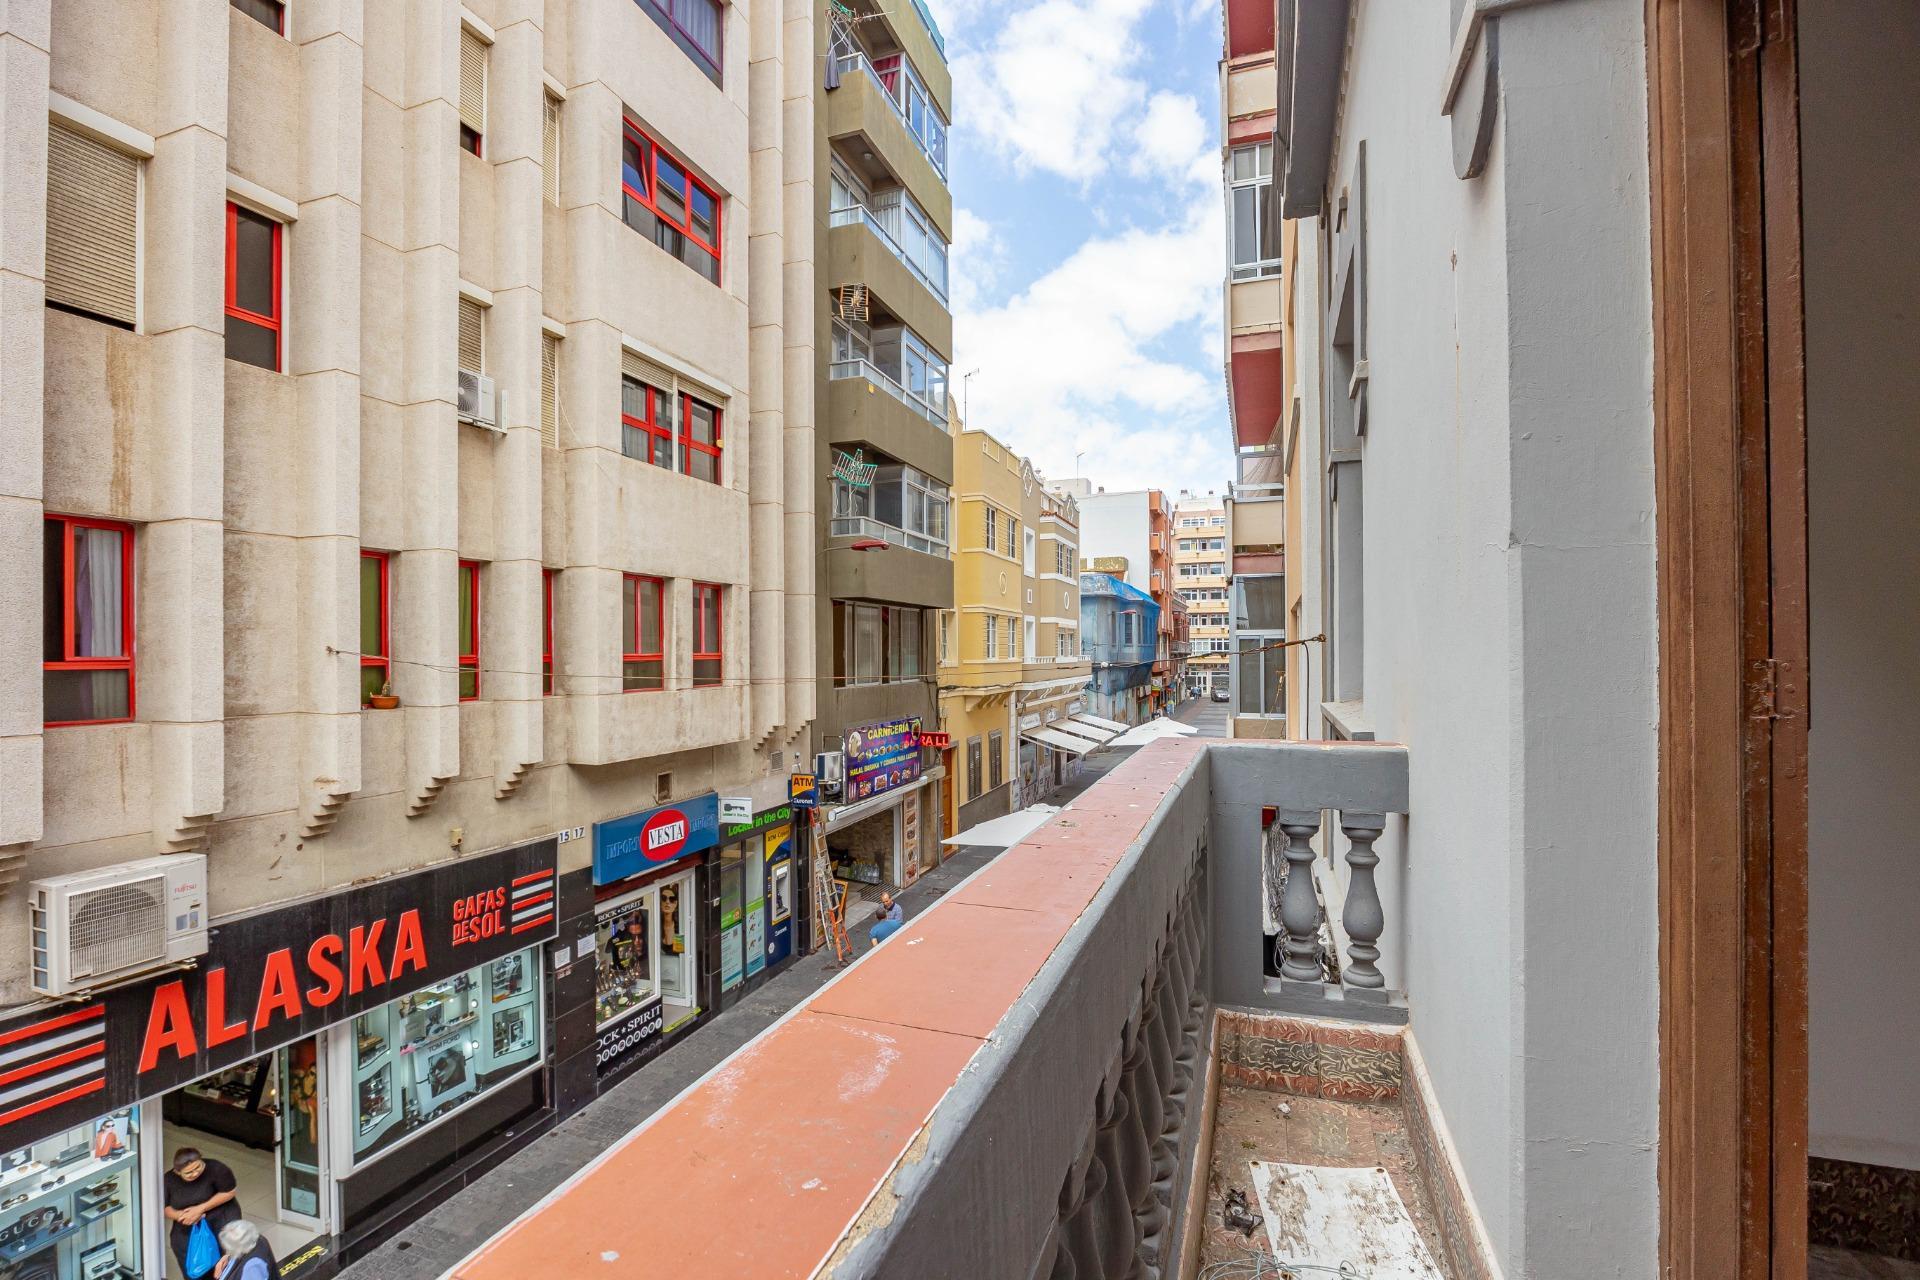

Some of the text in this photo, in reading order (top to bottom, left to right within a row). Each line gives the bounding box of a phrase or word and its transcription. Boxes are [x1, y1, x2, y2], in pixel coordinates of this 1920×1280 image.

[793, 777, 814, 787] ATM
[755, 816, 763, 828] in
[764, 811, 776, 824] the
[776, 807, 791, 820] City
[559, 827, 584, 842] 15 17
[650, 822, 683, 847] VESTA
[453, 886, 507, 922] GAFAS
[598, 900, 642, 922] ROCK SPIRIT
[453, 910, 506, 943] DE SOL
[137, 908, 428, 1075] ALASKA
[627, 1004, 662, 1032] SPIRIT
[427, 1033, 461, 1053] TOM FORD
